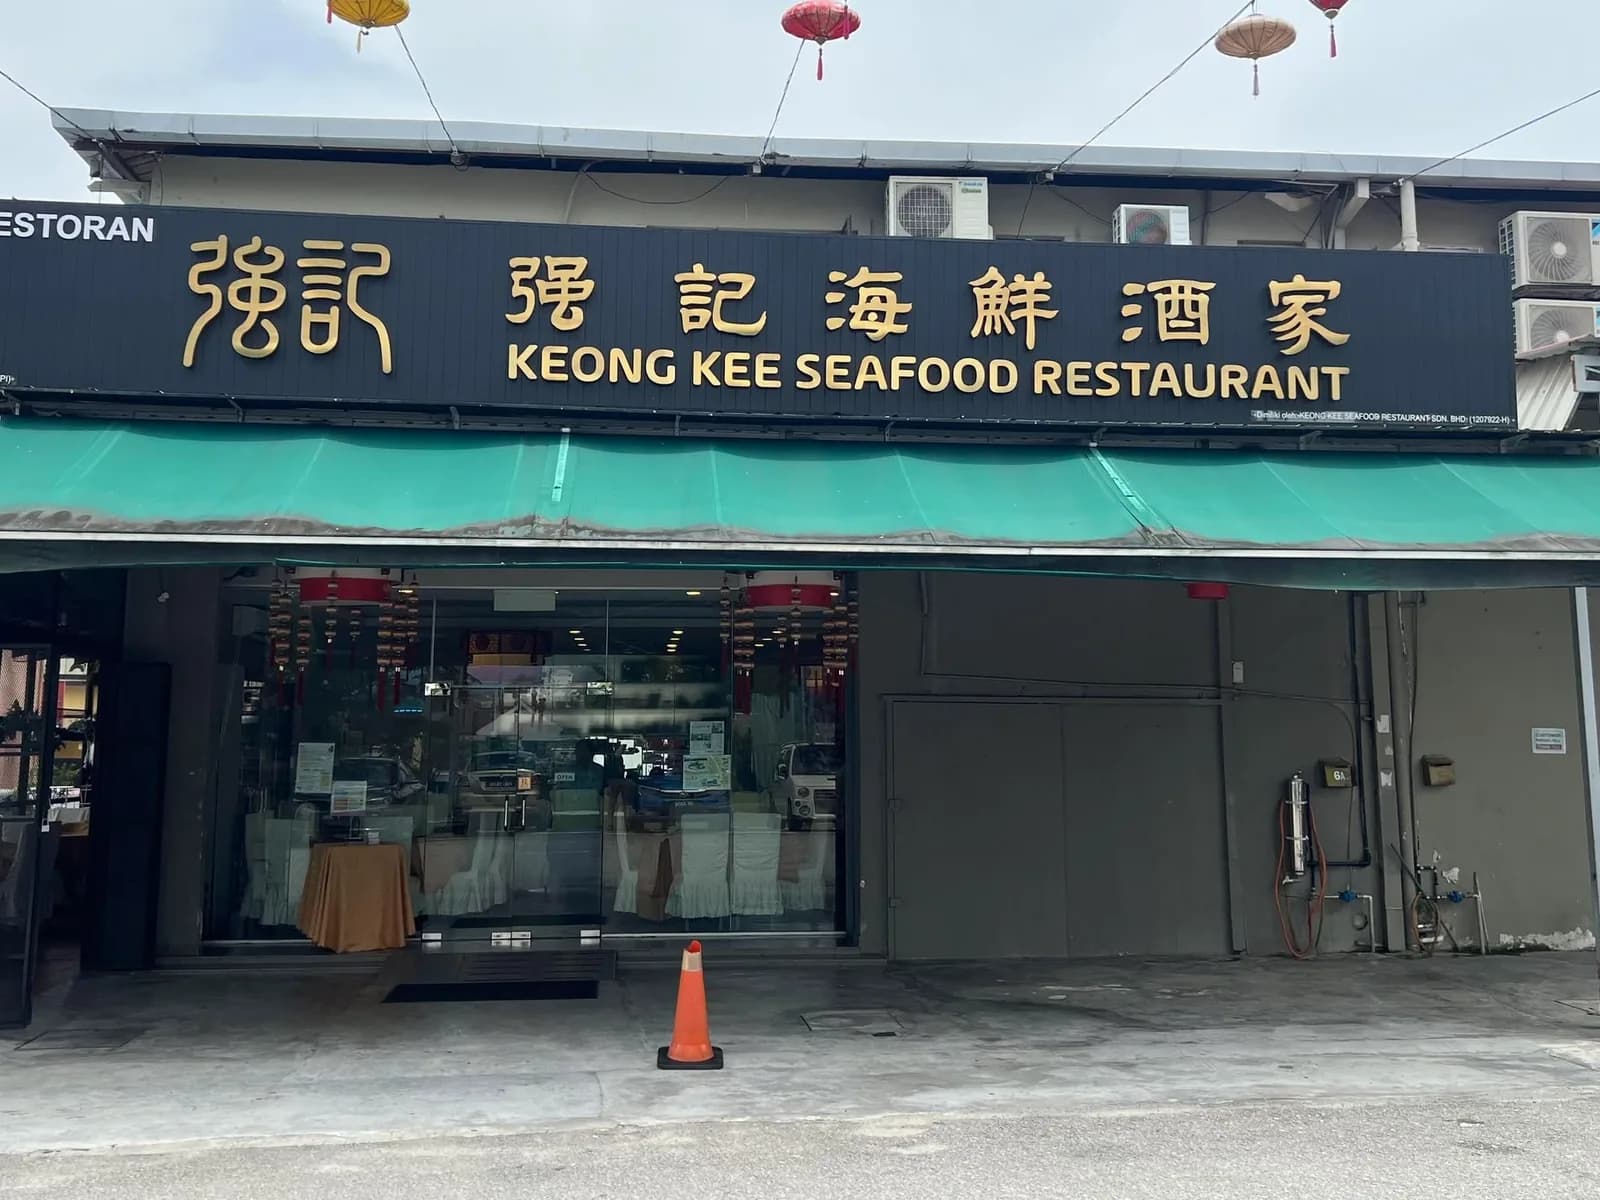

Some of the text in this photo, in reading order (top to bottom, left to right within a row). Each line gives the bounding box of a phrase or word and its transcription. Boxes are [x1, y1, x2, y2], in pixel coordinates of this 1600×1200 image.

[0, 211, 154, 242] ESTORAN
[508, 344, 1349, 401] KEONG KEE SEAFOOD RESTAURANT
[1381, 413, 1431, 422] RESTAURANT
